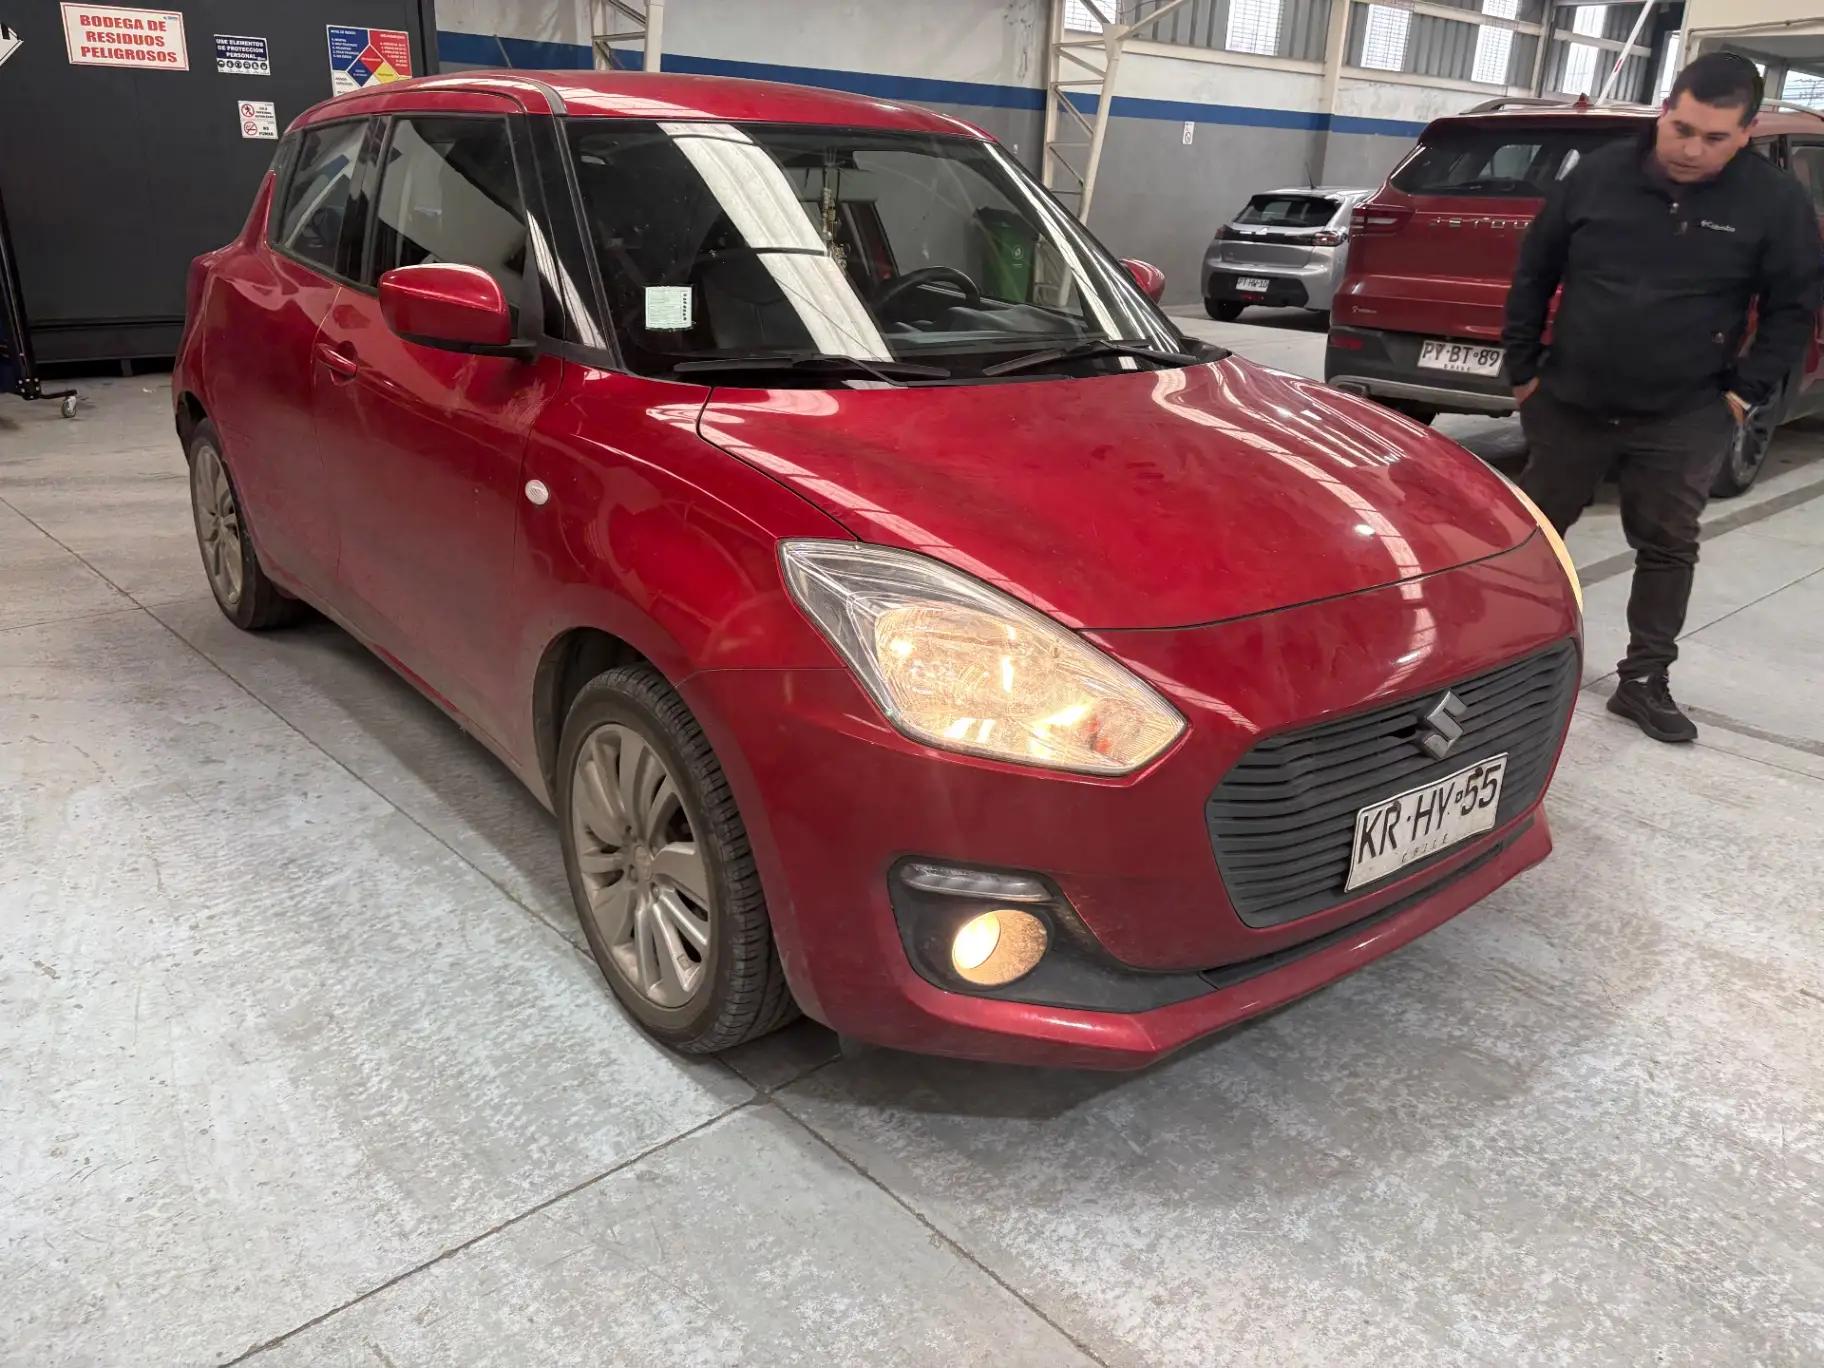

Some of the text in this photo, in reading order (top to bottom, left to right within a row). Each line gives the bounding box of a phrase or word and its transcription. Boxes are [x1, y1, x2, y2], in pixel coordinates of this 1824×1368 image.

[80, 15, 167, 32] BODEGA DE
[86, 31, 165, 47] RESIDUOS
[80, 46, 178, 63] PELIGROSOS
